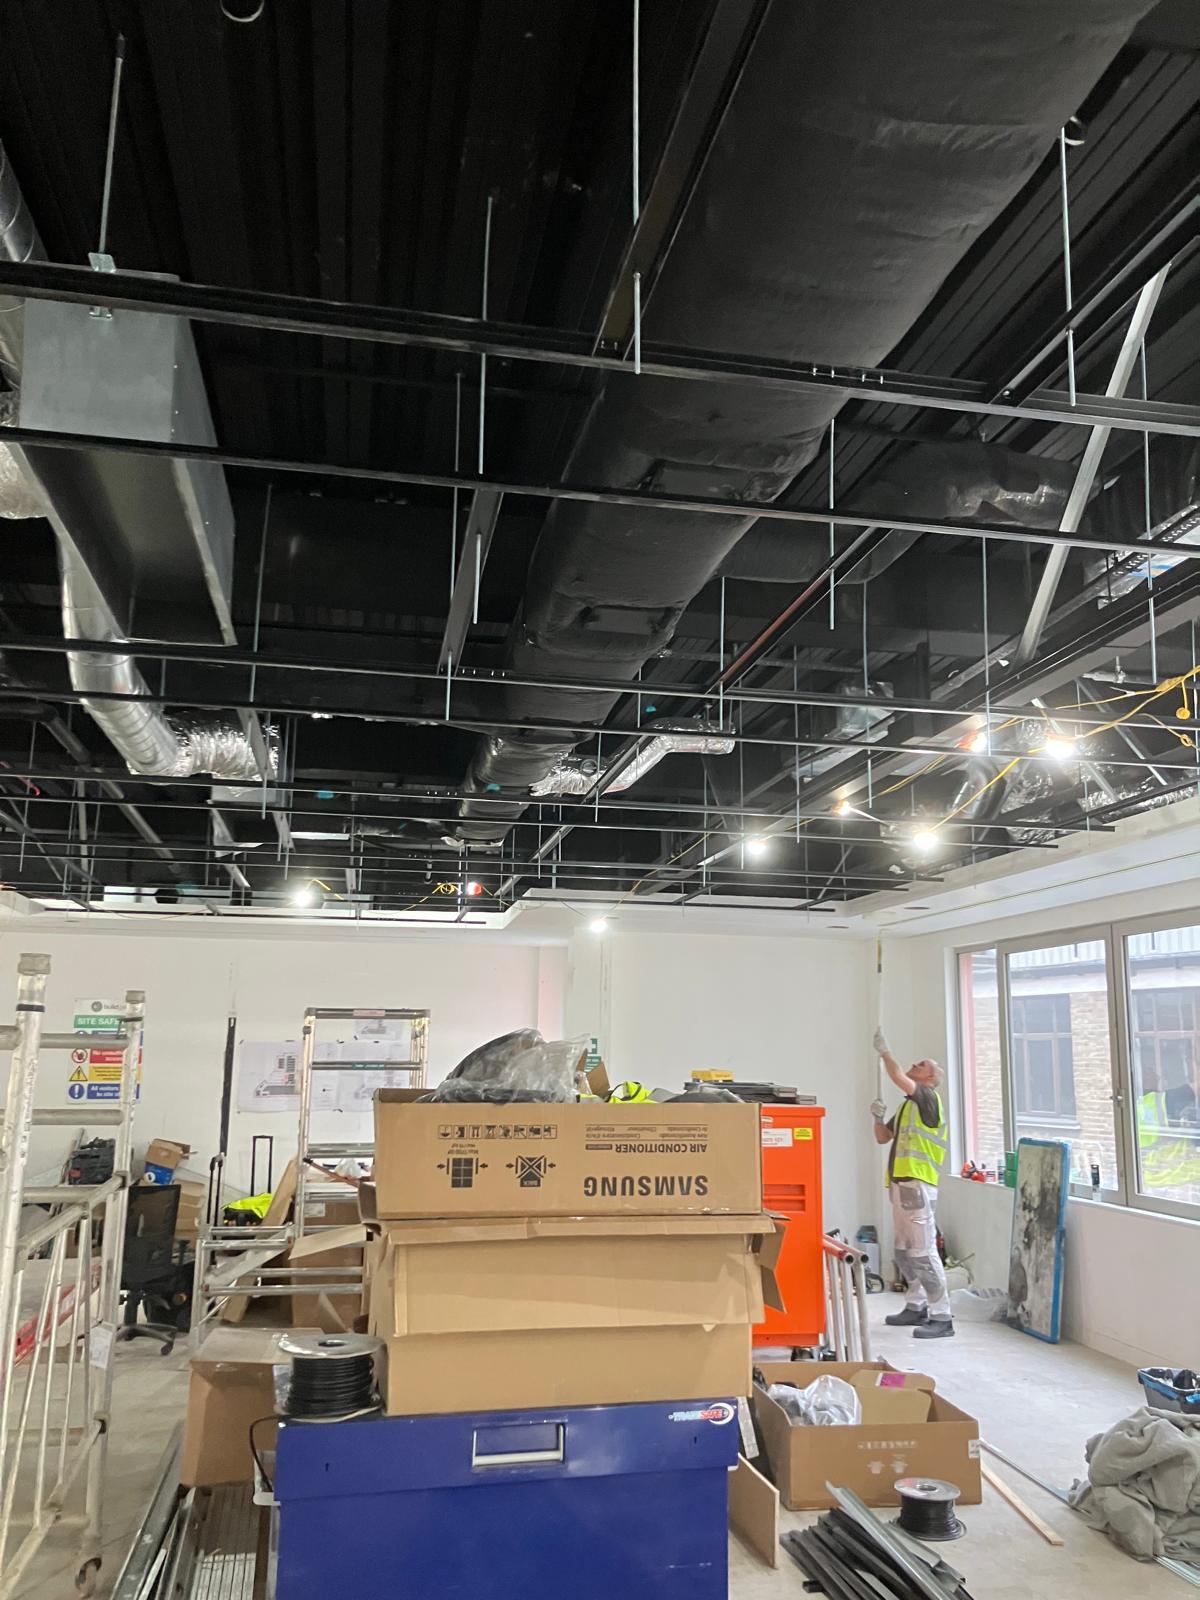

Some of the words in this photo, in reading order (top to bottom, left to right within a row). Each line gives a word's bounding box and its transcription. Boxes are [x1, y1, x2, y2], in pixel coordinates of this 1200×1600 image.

[77, 1017, 97, 1025] SITE
[98, 1017, 125, 1025] SAFE
[615, 1143, 688, 1153] CONDITIONER
[689, 1143, 708, 1153] AIR
[583, 1175, 708, 1197] SAMSUNG
